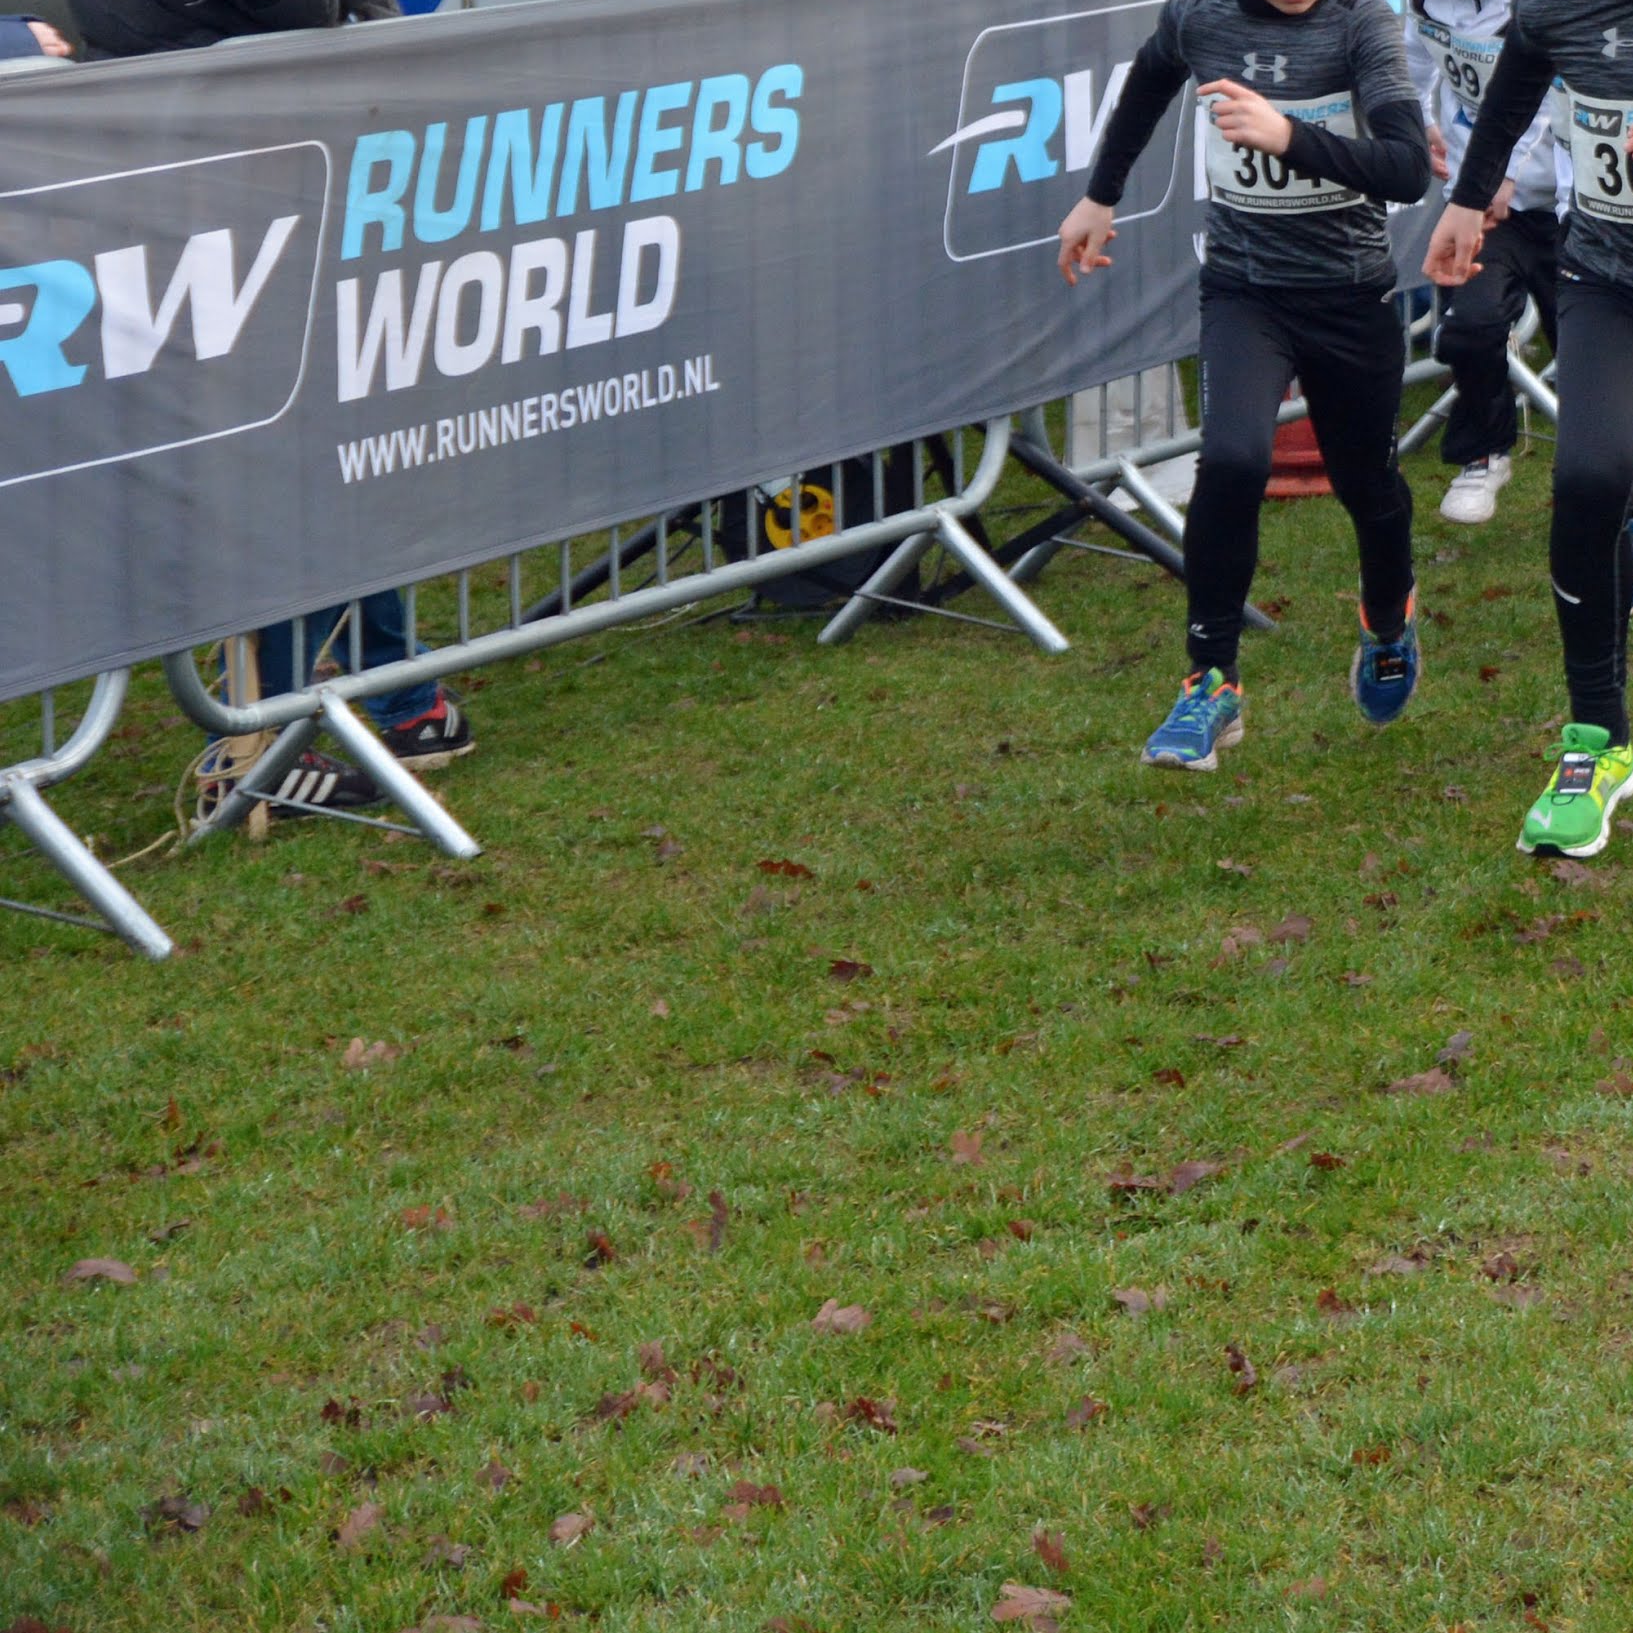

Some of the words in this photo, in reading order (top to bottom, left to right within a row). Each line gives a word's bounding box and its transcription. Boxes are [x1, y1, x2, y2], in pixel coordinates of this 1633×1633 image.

[1444, 53, 1480, 97] 99
[1452, 47, 1495, 64] WORLD
[340, 63, 804, 261] RUNNERS
[1232, 143, 1321, 189] 30
[1225, 192, 1345, 208] WWW.RUNNERSWORLD.NL
[336, 215, 681, 403] WORLD
[337, 353, 721, 484] WWW.RUNNERSWORLD.NL
